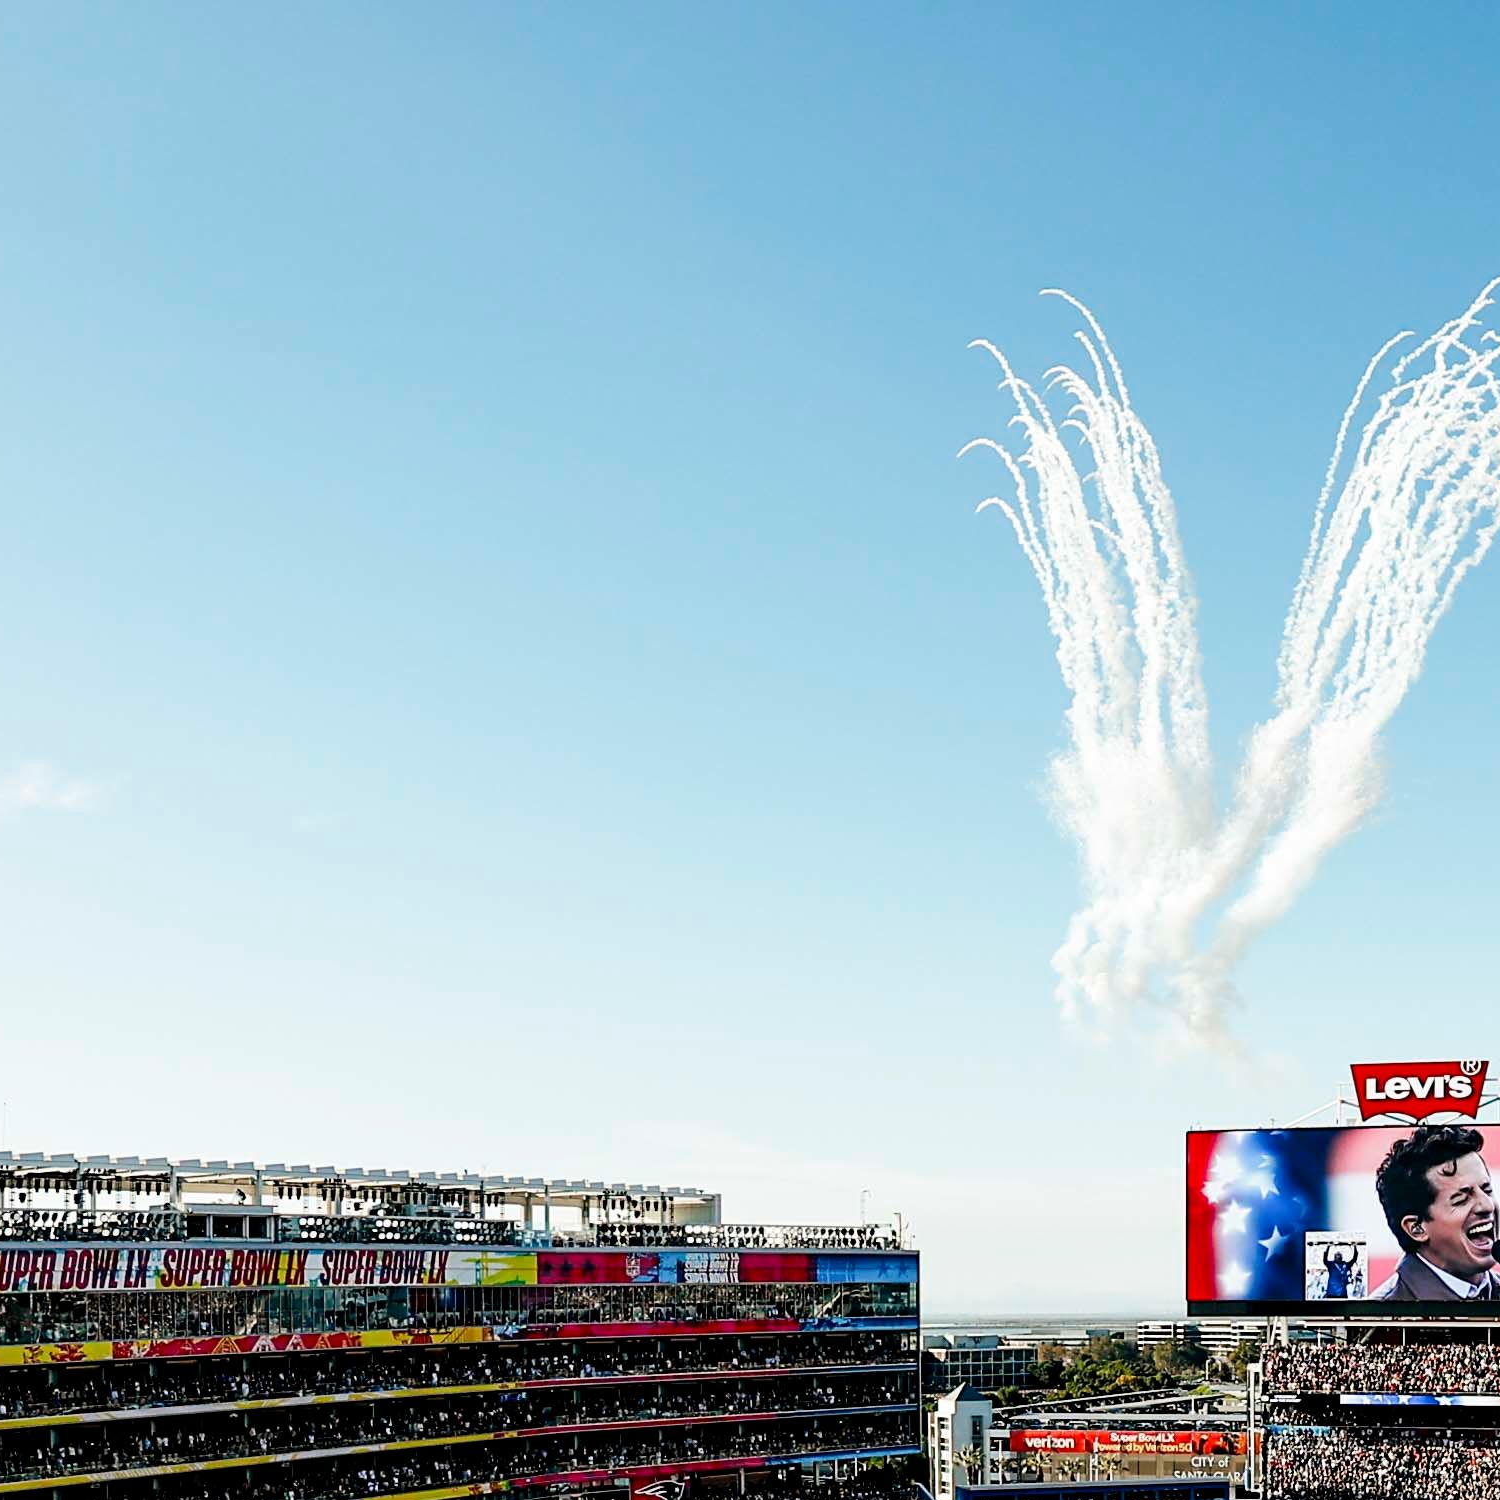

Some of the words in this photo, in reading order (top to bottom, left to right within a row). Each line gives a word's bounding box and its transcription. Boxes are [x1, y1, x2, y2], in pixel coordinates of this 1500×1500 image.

[60, 1249, 119, 1291] BOWL
[124, 1249, 152, 1290] LX
[160, 1249, 227, 1289] SUPER
[230, 1249, 282, 1287] BOWL
[284, 1249, 309, 1286] LX
[320, 1249, 377, 1286] SUPER
[379, 1249, 424, 1285] BOWL
[428, 1249, 449, 1285] LX
[1025, 1437, 1075, 1449] verizon
[1110, 1432, 1137, 1444] Super
[1191, 1456, 1214, 1468] CITY
[1218, 1456, 1229, 1468] of
